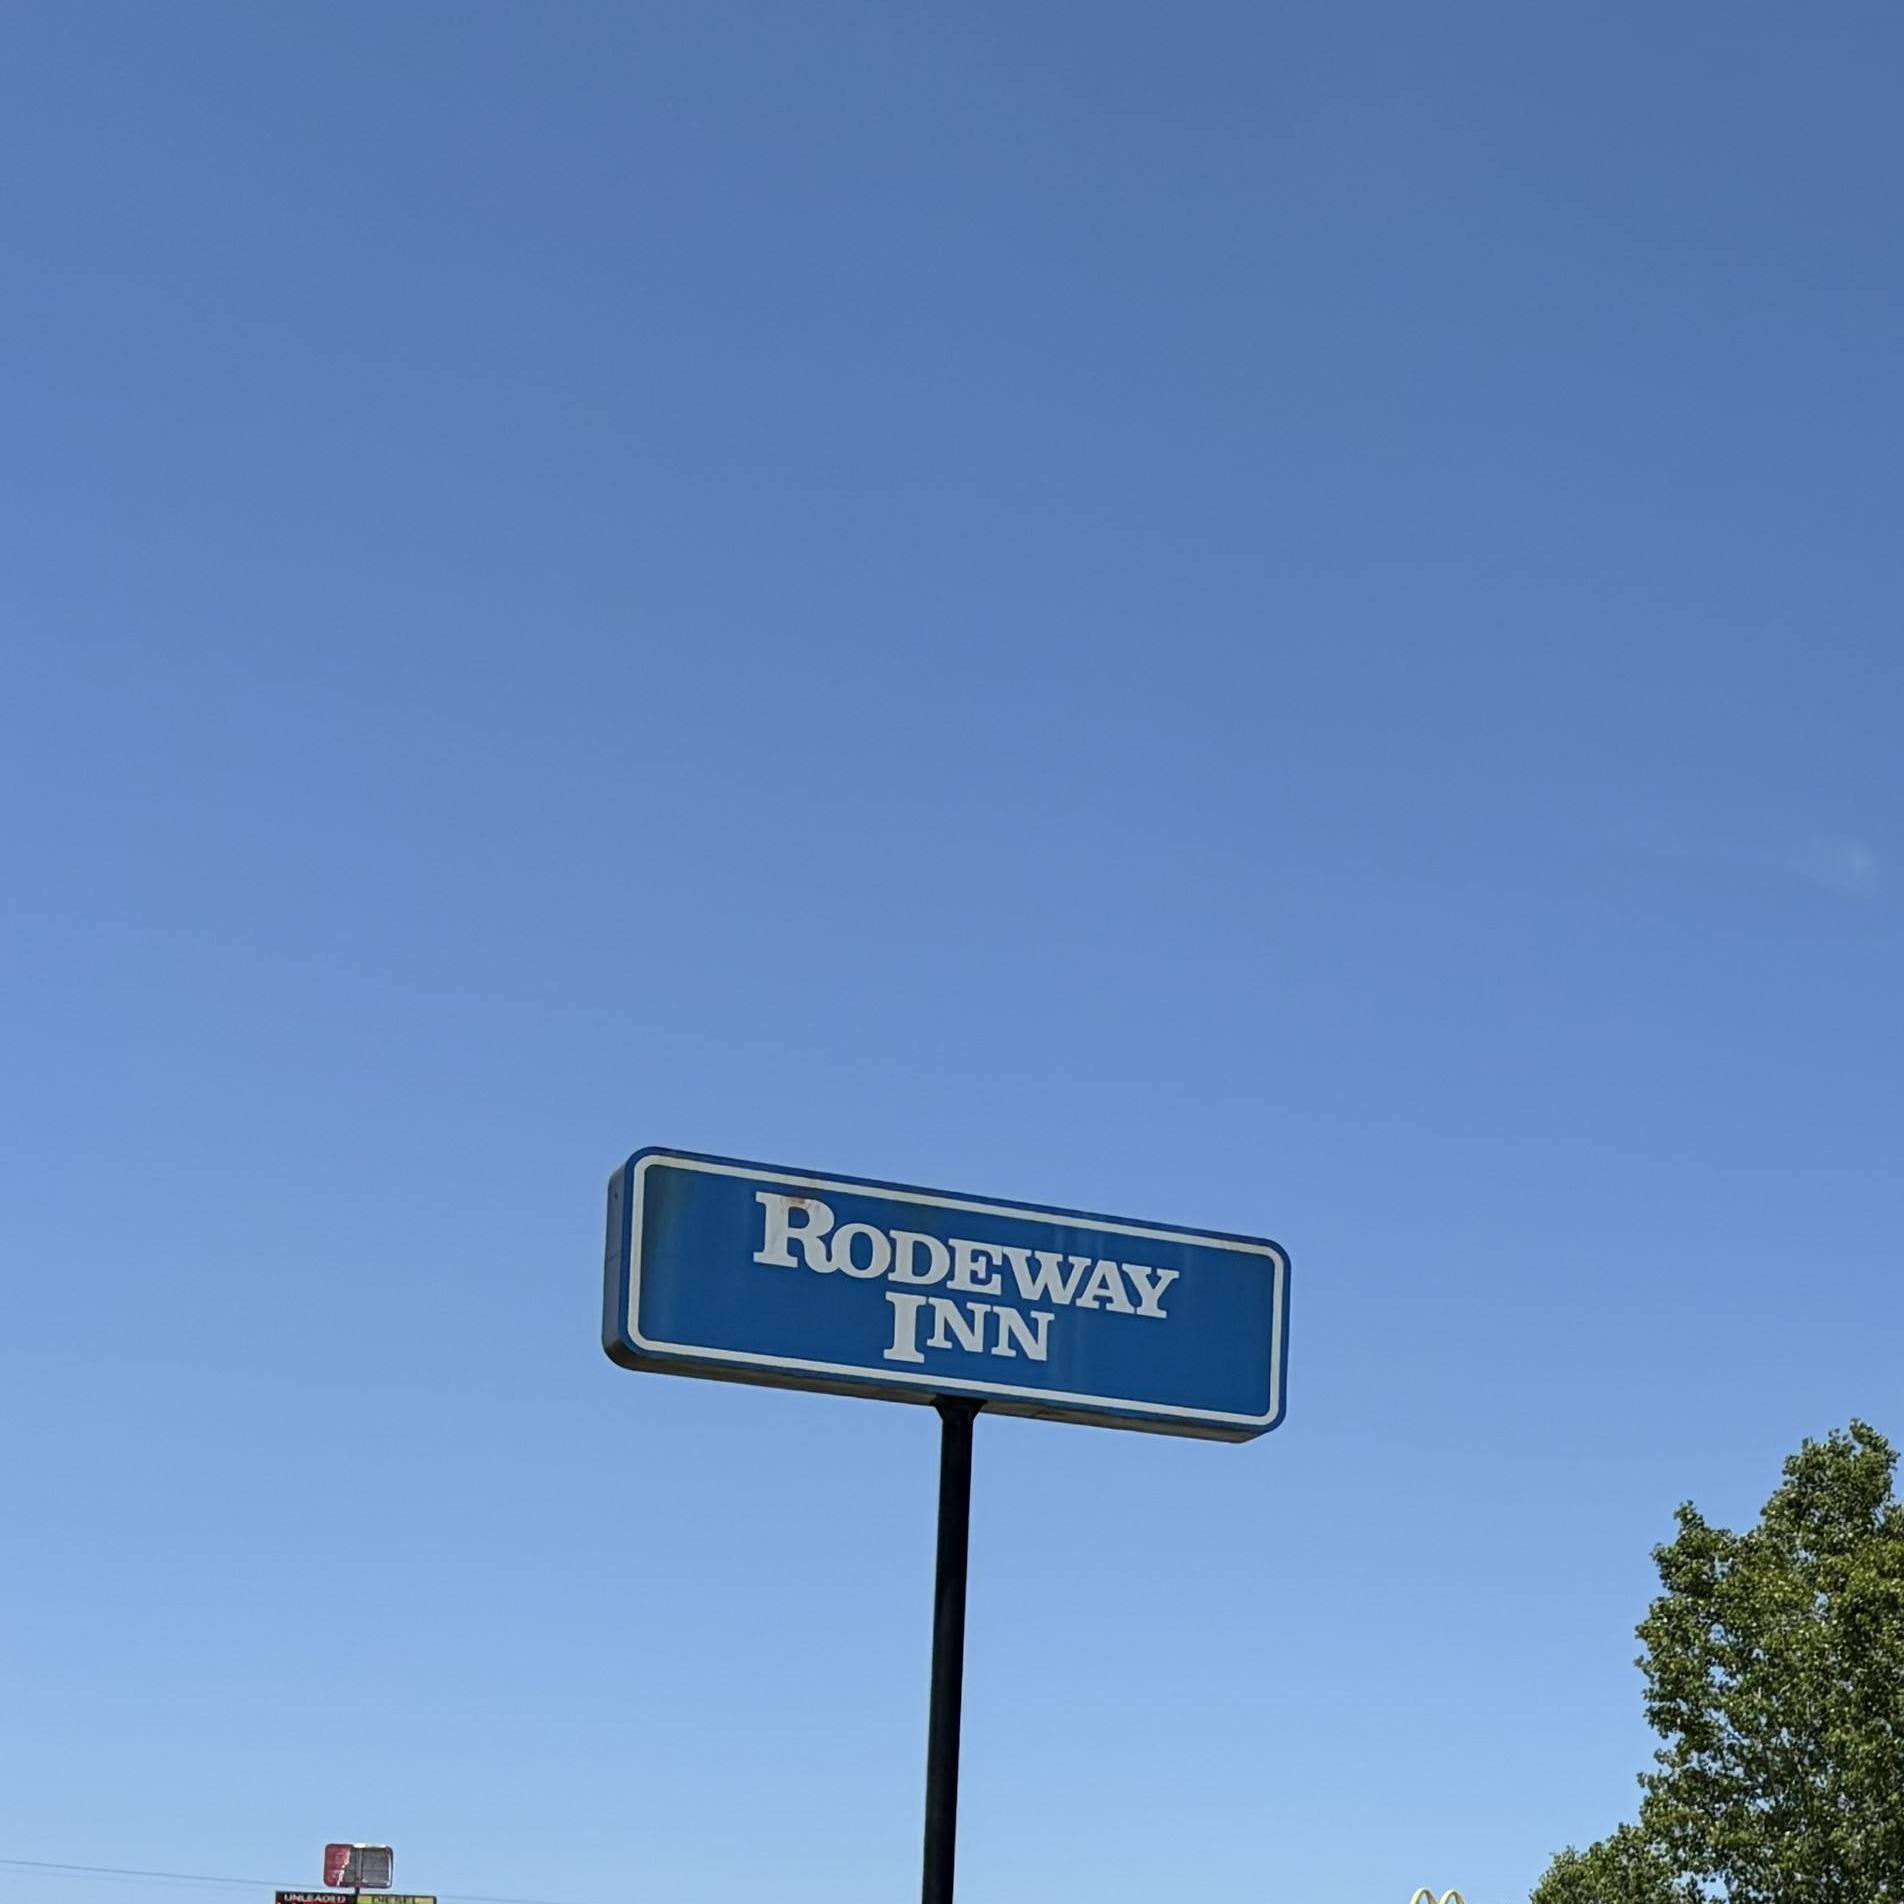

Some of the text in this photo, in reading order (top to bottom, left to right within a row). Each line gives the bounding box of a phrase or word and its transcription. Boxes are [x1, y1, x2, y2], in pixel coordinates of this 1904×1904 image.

[753, 1192, 1179, 1318] RODEWAY
[884, 1292, 1055, 1363] INN
[284, 1894, 346, 1904] UNLEADED
